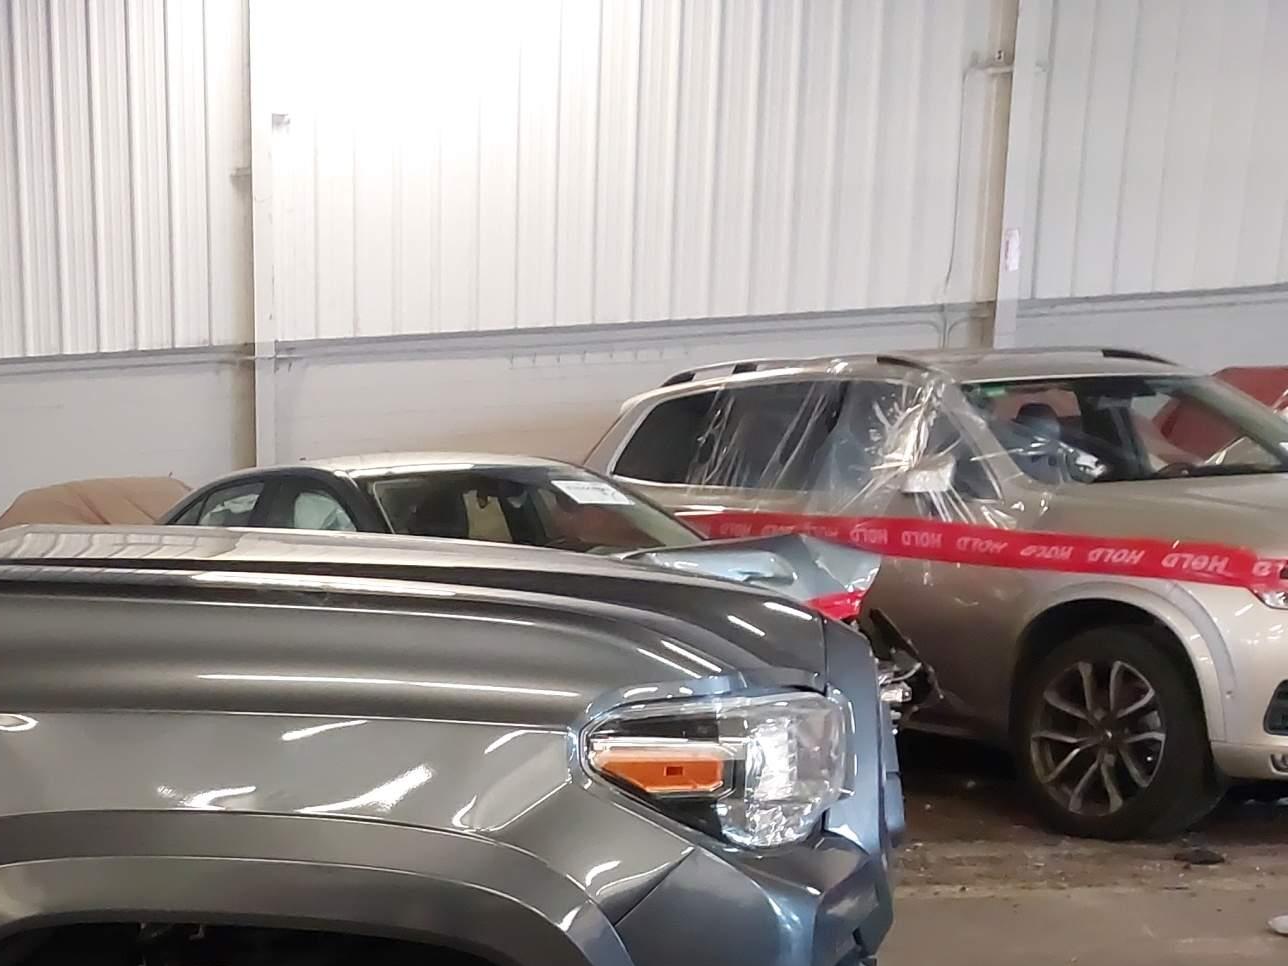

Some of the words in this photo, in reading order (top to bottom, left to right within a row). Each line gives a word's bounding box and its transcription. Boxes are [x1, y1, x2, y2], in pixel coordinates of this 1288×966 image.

[850, 527, 888, 544] HOLD
[901, 530, 942, 547] HOLD
[956, 537, 1009, 553] HOLD
[1019, 545, 1074, 560] HOLD
[1088, 547, 1145, 565] HOLD
[1161, 553, 1229, 574] HOLD
